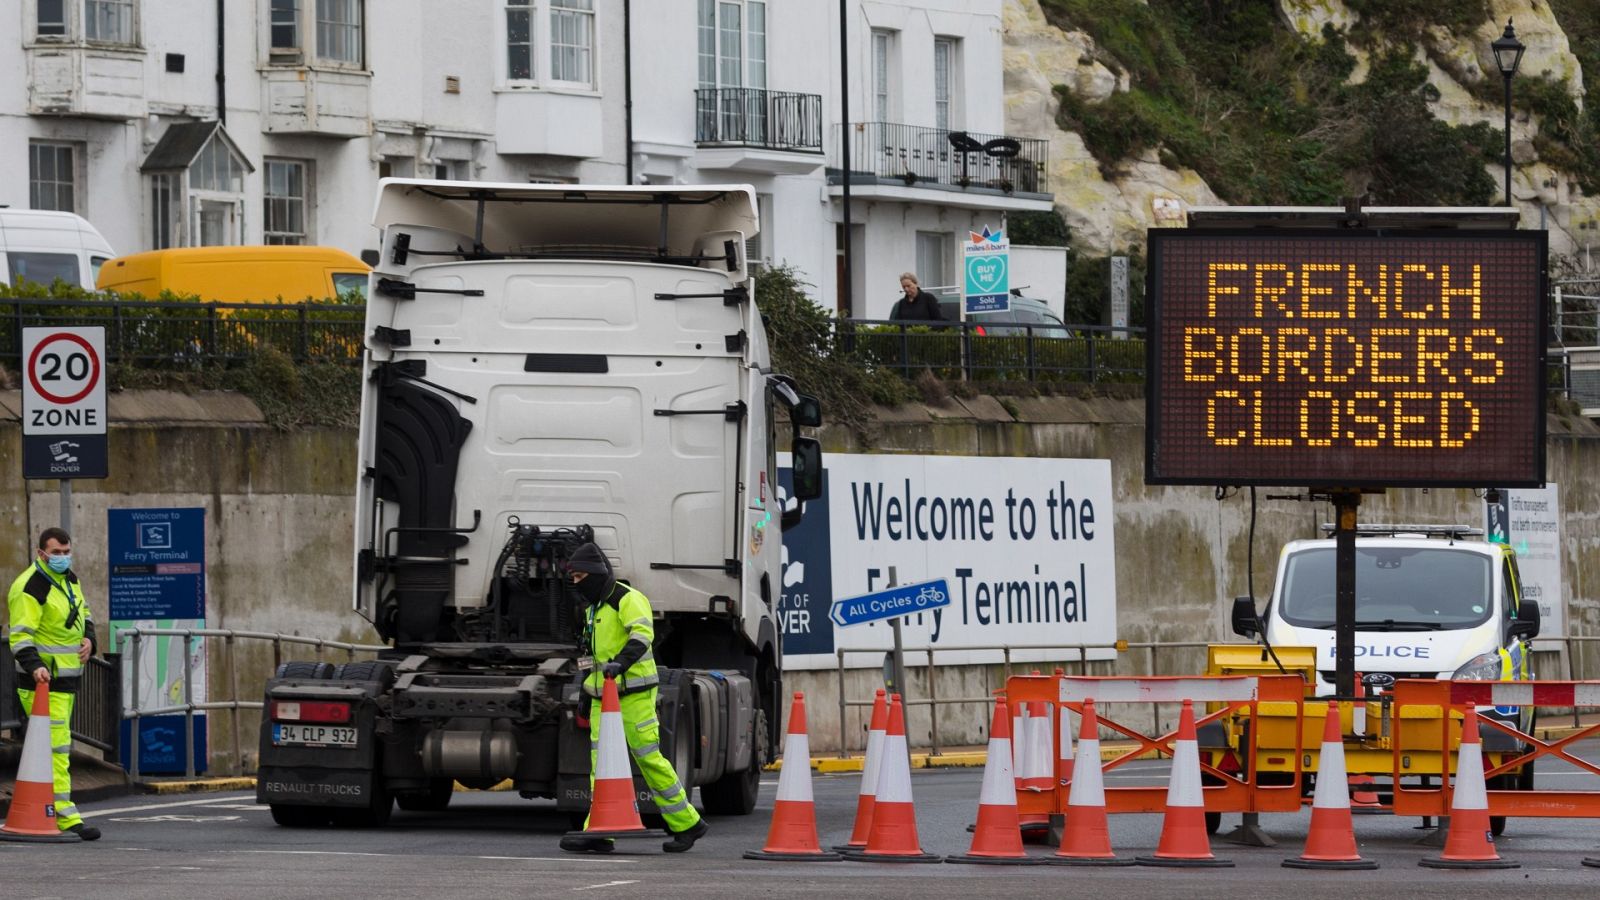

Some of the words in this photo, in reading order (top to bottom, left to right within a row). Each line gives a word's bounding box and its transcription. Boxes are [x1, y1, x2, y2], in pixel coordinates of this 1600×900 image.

[967, 244, 1007, 252] miles&barr
[977, 265, 996, 273] BUY
[980, 274, 994, 282] ME
[1208, 263, 1481, 320] FRENCH
[979, 296, 996, 304] Sold
[1184, 327, 1504, 384] BORDERS
[40, 352, 89, 381] 20
[31, 409, 97, 426] ZONE
[1207, 390, 1480, 448] CLOSED
[131, 512, 169, 520] Welcome
[851, 478, 994, 541] Welcome
[1005, 488, 1036, 541] to
[1046, 480, 1095, 541] the
[124, 552, 147, 562] Ferry
[149, 551, 188, 560] Terminal
[794, 594, 809, 607] OF
[955, 563, 1087, 625] Terminal
[849, 603, 867, 616] All
[870, 596, 912, 612] Cycles
[777, 610, 811, 633] VER
[281, 727, 296, 741] 34
[302, 728, 325, 742] CLP
[332, 729, 355, 743] 932
[266, 782, 315, 793] RENAULT
[318, 784, 361, 795] TRUCKS
